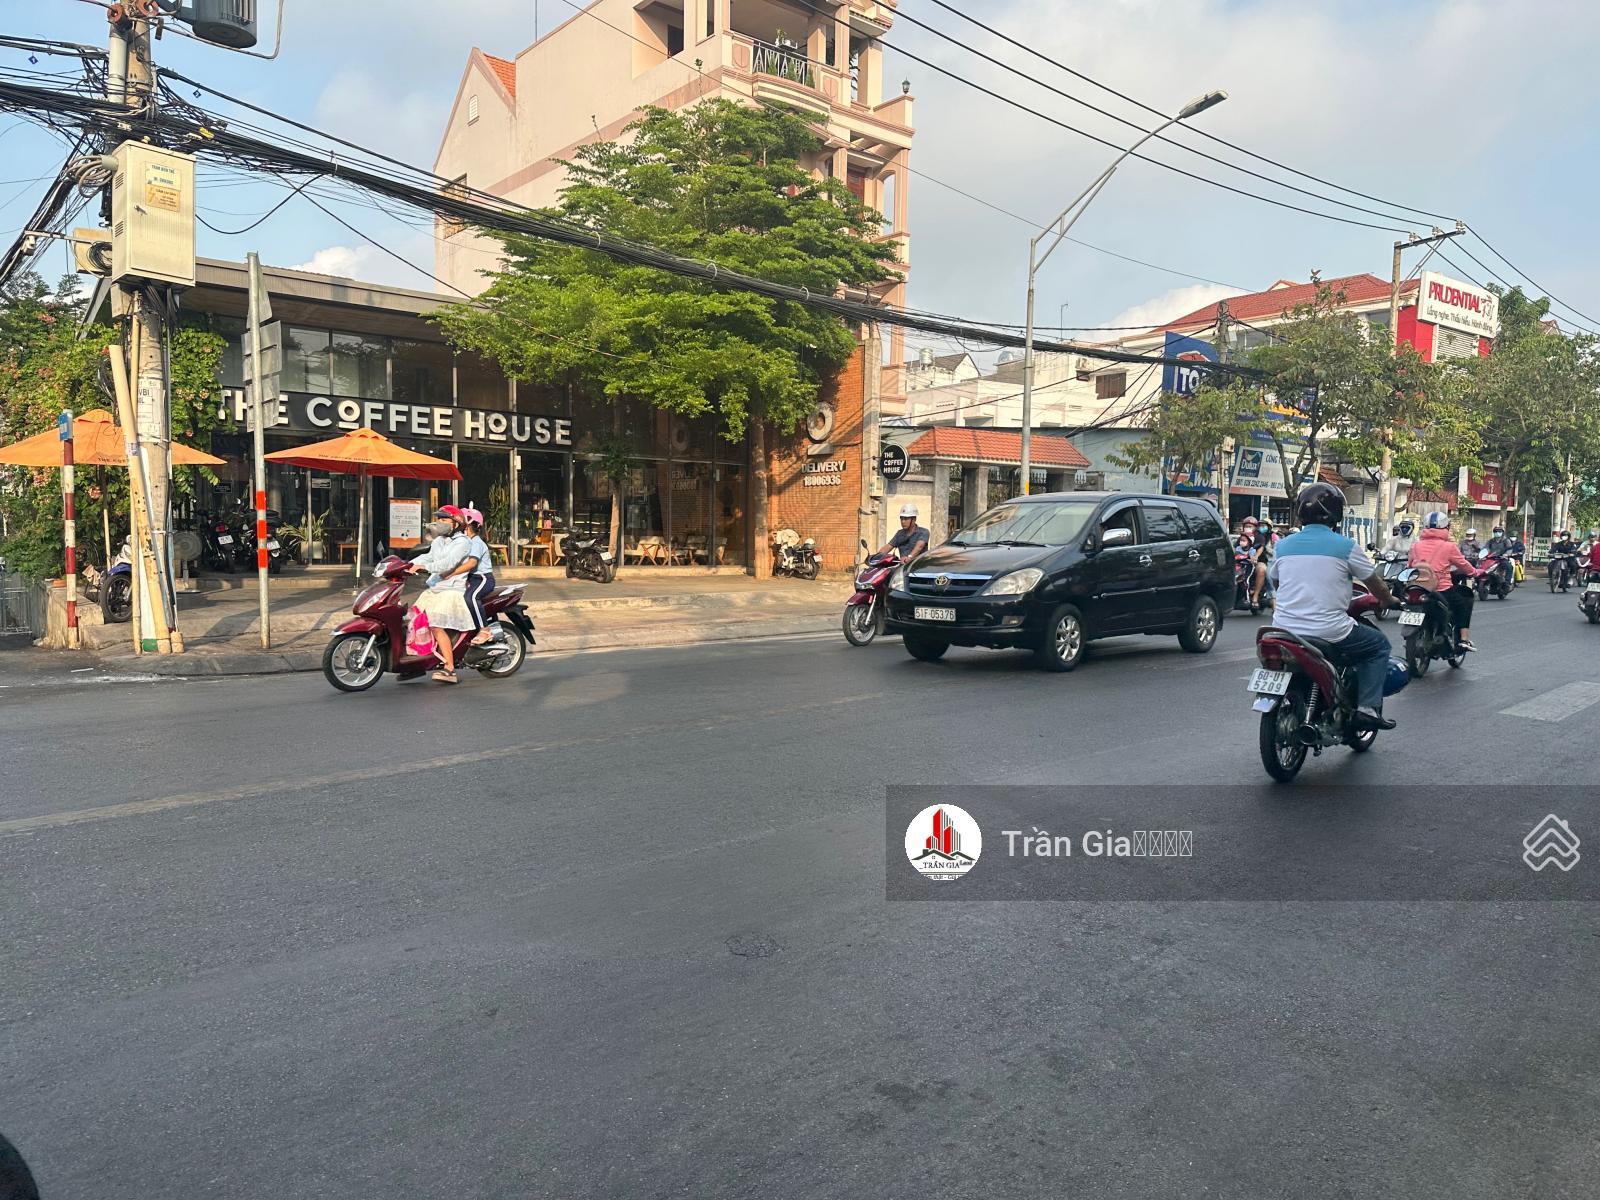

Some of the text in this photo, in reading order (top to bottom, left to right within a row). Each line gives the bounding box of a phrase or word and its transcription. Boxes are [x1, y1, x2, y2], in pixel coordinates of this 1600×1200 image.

[1429, 280, 1482, 314] PRUDENTIAL
[306, 396, 453, 437] COFFEE
[464, 410, 572, 446] HOUSE
[883, 451, 894, 459] THE
[801, 460, 847, 474] DELIVERY
[883, 466, 901, 474] HOUSE
[1253, 680, 1282, 693] 5209
